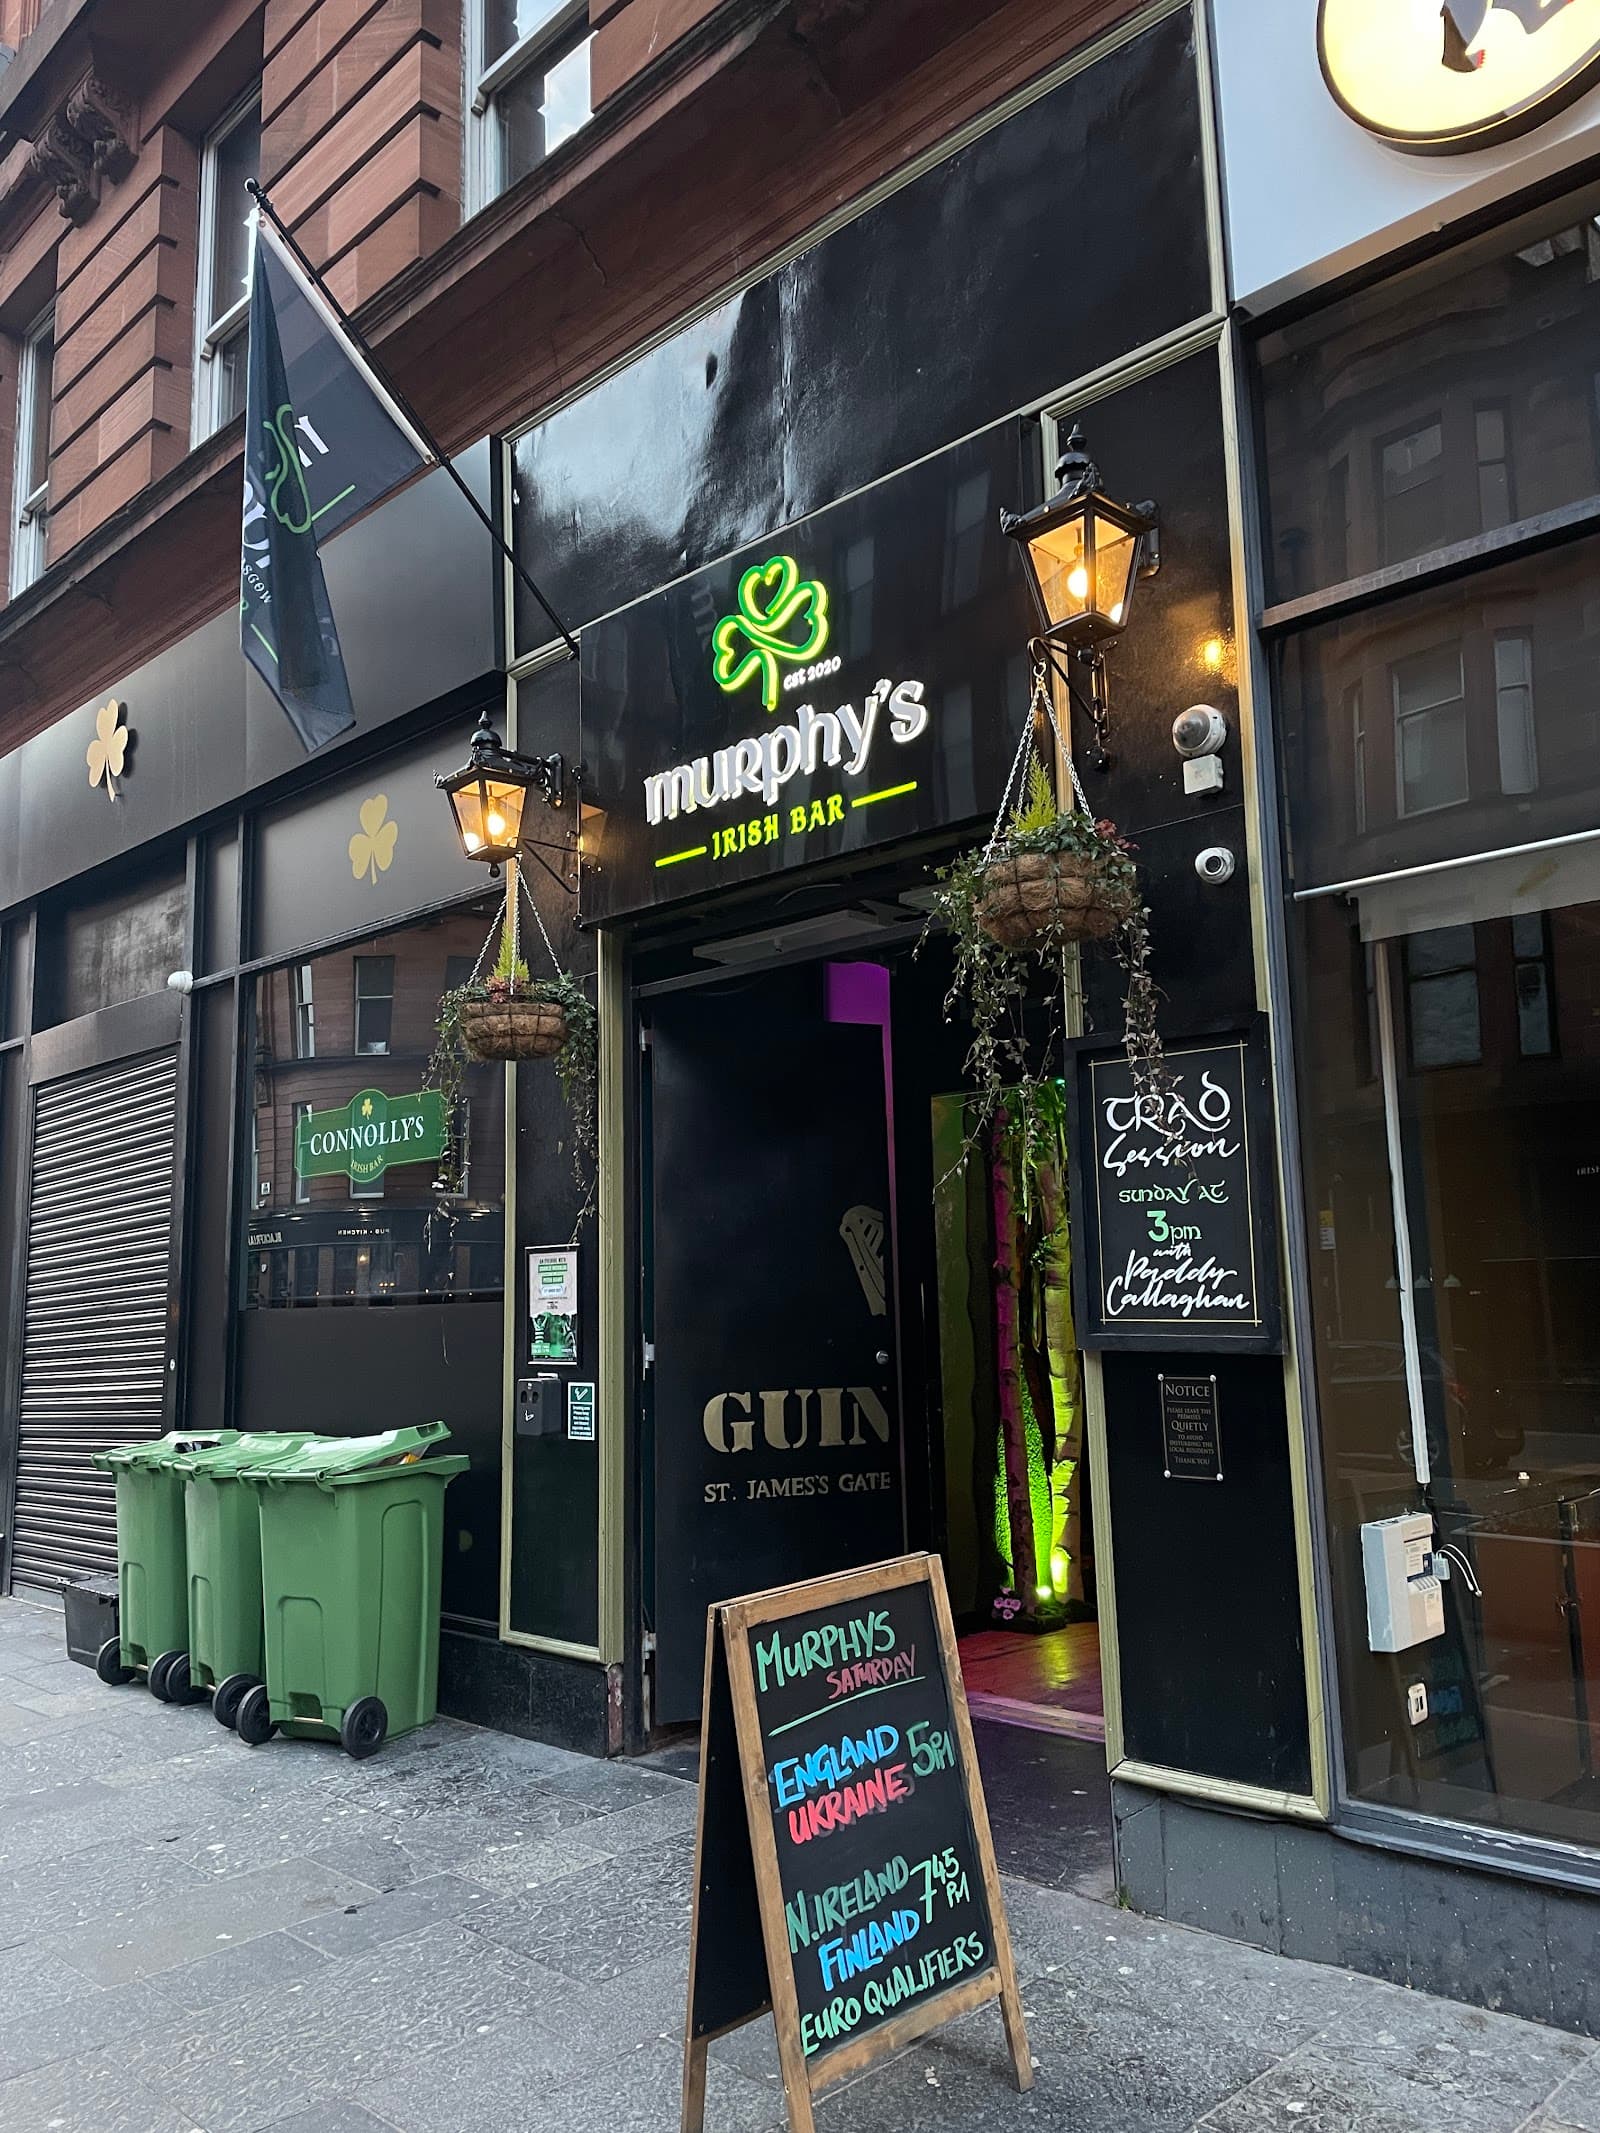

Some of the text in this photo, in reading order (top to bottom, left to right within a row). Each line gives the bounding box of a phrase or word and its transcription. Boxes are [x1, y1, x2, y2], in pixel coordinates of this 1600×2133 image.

[783, 656, 842, 691] est 2020
[712, 793, 845, 861] IRISH BAR
[310, 1115, 425, 1156] CONNOLLY'S
[1103, 1132, 1241, 1178] Session
[350, 1154, 384, 1174] IRISH BAR
[1124, 1249, 1238, 1291] Paddy
[1152, 1242, 1192, 1260] with
[1106, 1275, 1250, 1317] Callaghan
[1165, 1383, 1211, 1397] NOTICE
[703, 1387, 889, 1453] GUIN
[1171, 1420, 1209, 1432] QUIETLY
[704, 1472, 891, 1503] ST. JAMES'S GATE
[755, 1611, 896, 1693] MURPHYS
[826, 1644, 916, 1700] SATURDAY
[774, 1725, 900, 1808] ENGLAND
[788, 1762, 909, 1845] UKRAINE
[818, 1909, 921, 1992] FINLAND
[800, 1931, 984, 2057] EURO QUALIFIERS
